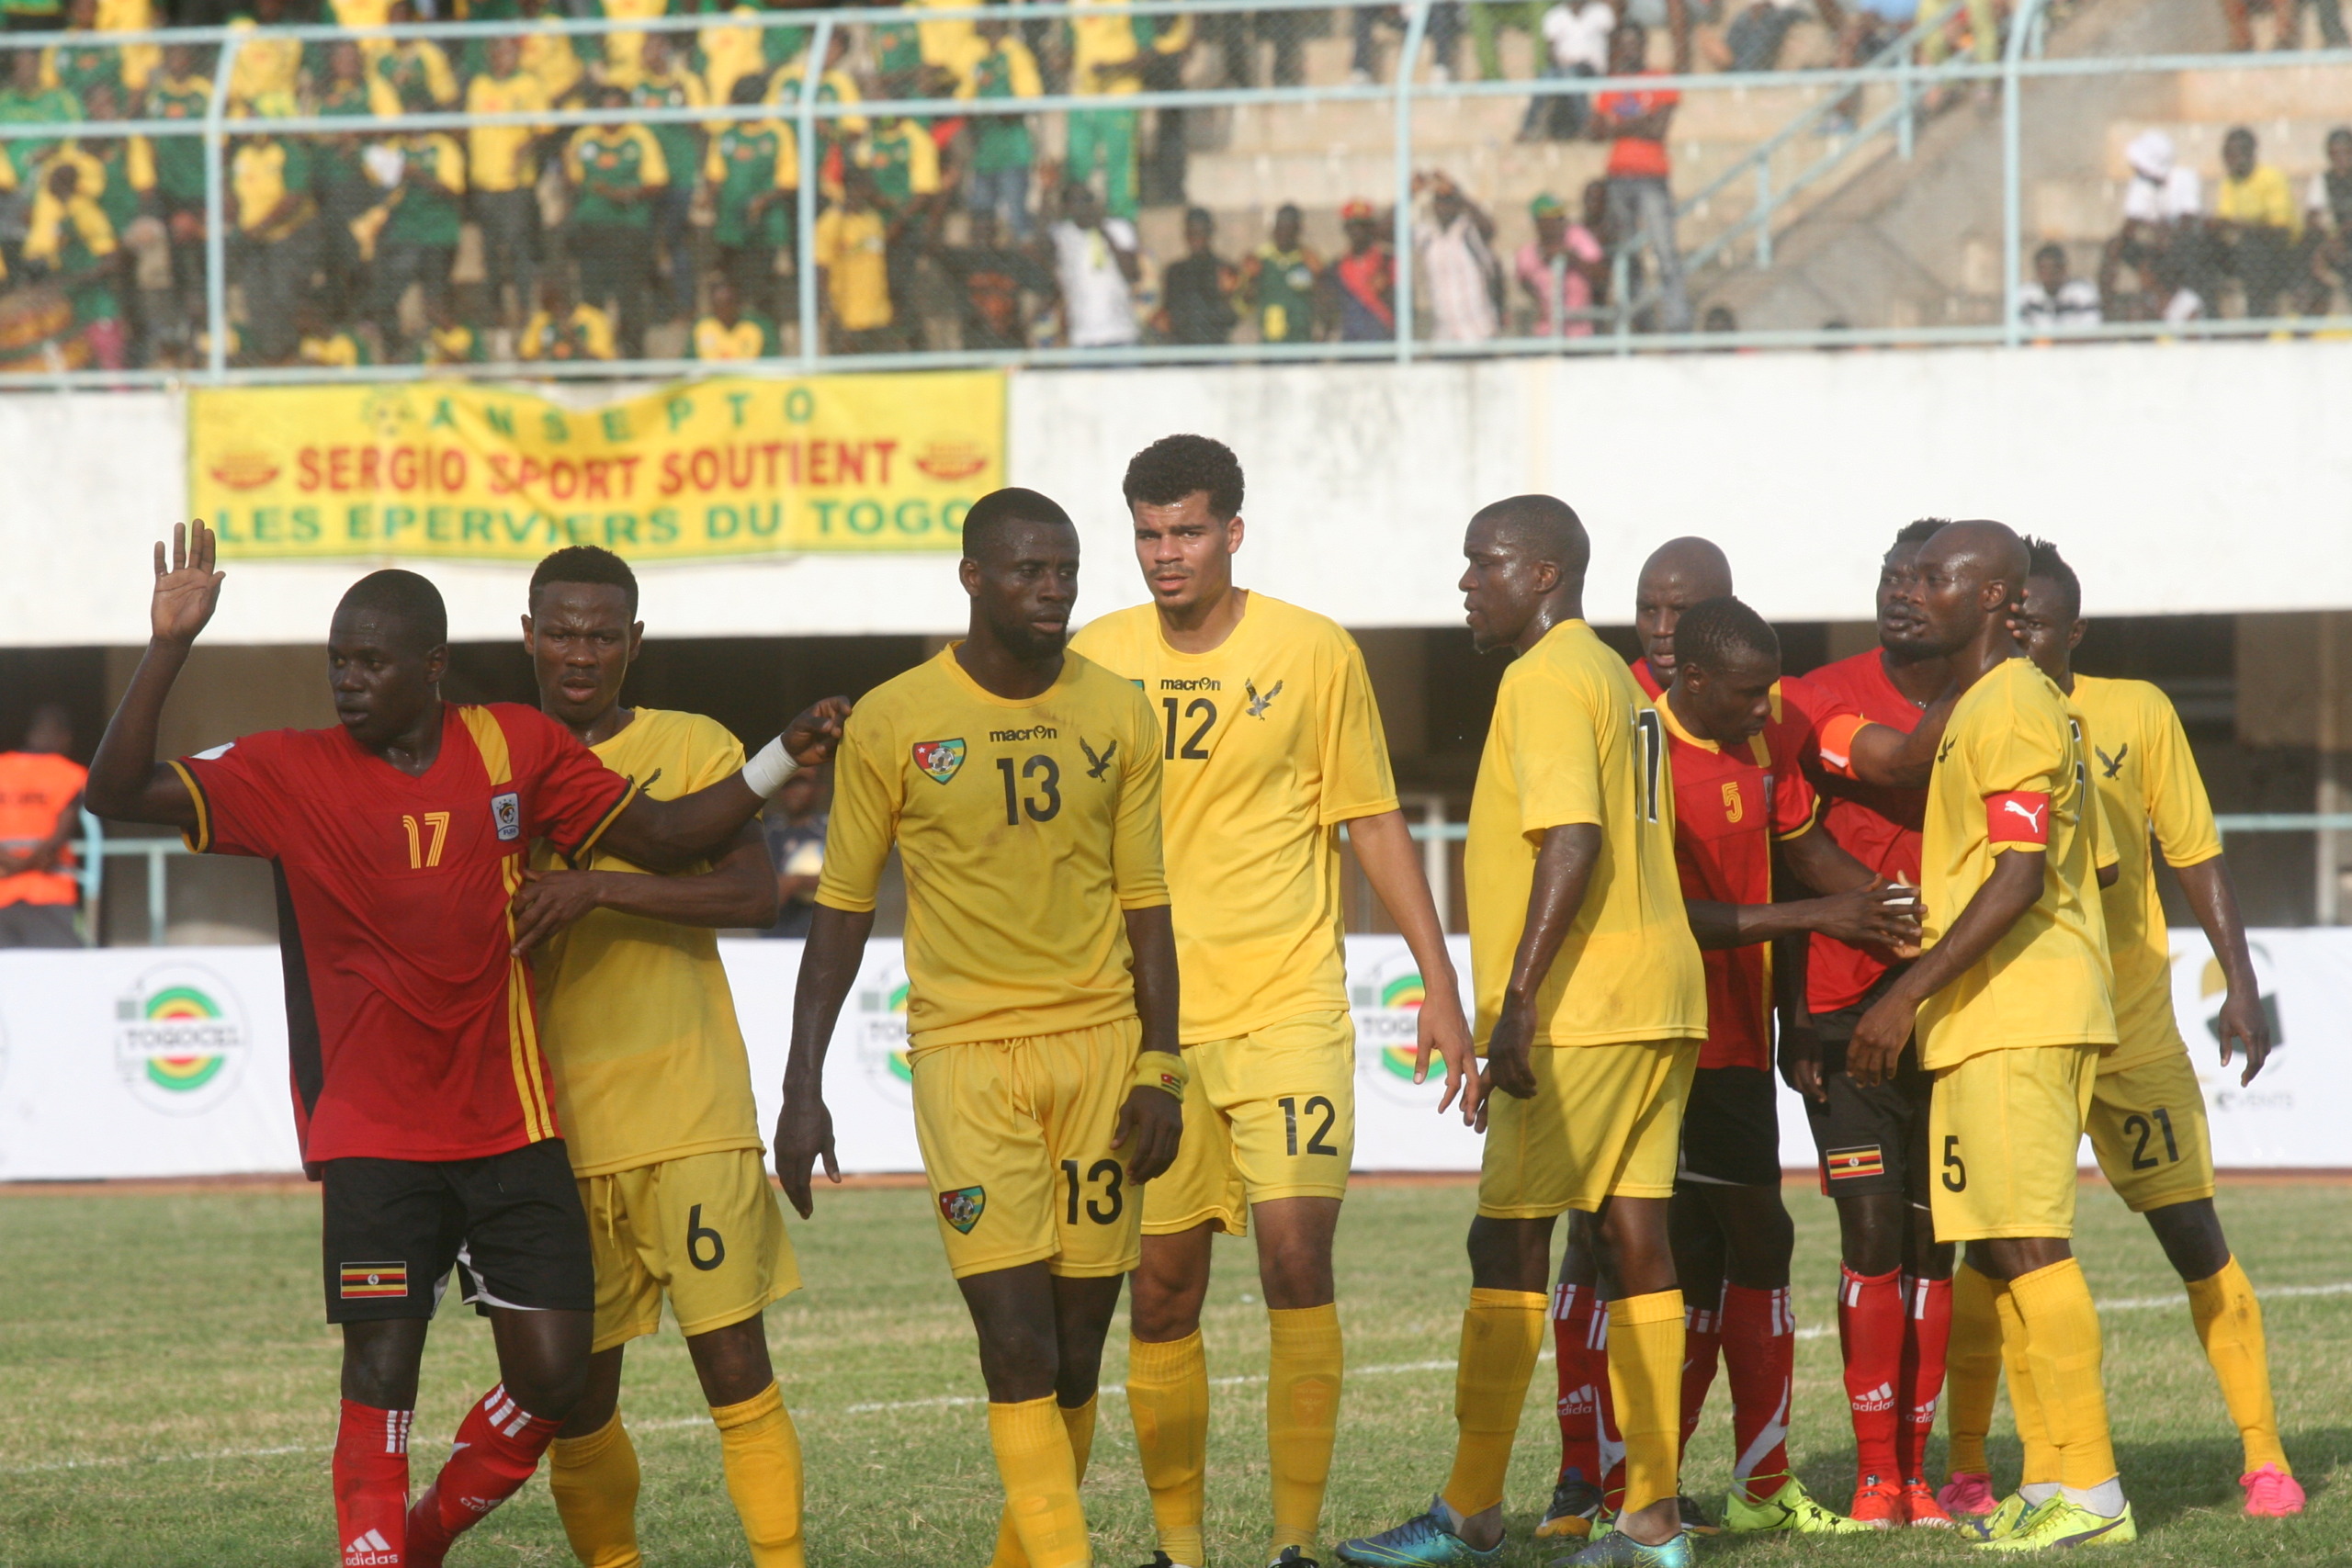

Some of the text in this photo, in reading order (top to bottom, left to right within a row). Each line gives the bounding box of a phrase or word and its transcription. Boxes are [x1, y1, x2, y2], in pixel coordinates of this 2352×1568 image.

[296, 446, 468, 492] SERGIO
[488, 451, 642, 501] SPORT
[658, 439, 899, 497] SOUTIENT
[217, 504, 322, 544] LES
[347, 504, 681, 547] EPERVIERS
[707, 502, 782, 540] DU
[1160, 676, 1222, 692] macron
[989, 725, 1057, 742] macron
[1162, 697, 1217, 761] 12
[996, 754, 1061, 826] 13
[1721, 781, 1744, 824] 5
[403, 811, 450, 870] 17
[1278, 1096, 1339, 1157] 12
[2123, 1107, 2180, 1172] 21
[1060, 1158, 1124, 1226] 13
[1941, 1134, 1967, 1193] 5
[686, 1203, 726, 1272] 6
[1852, 1398, 1895, 1412] adidas
[345, 1551, 399, 1566] adidas
